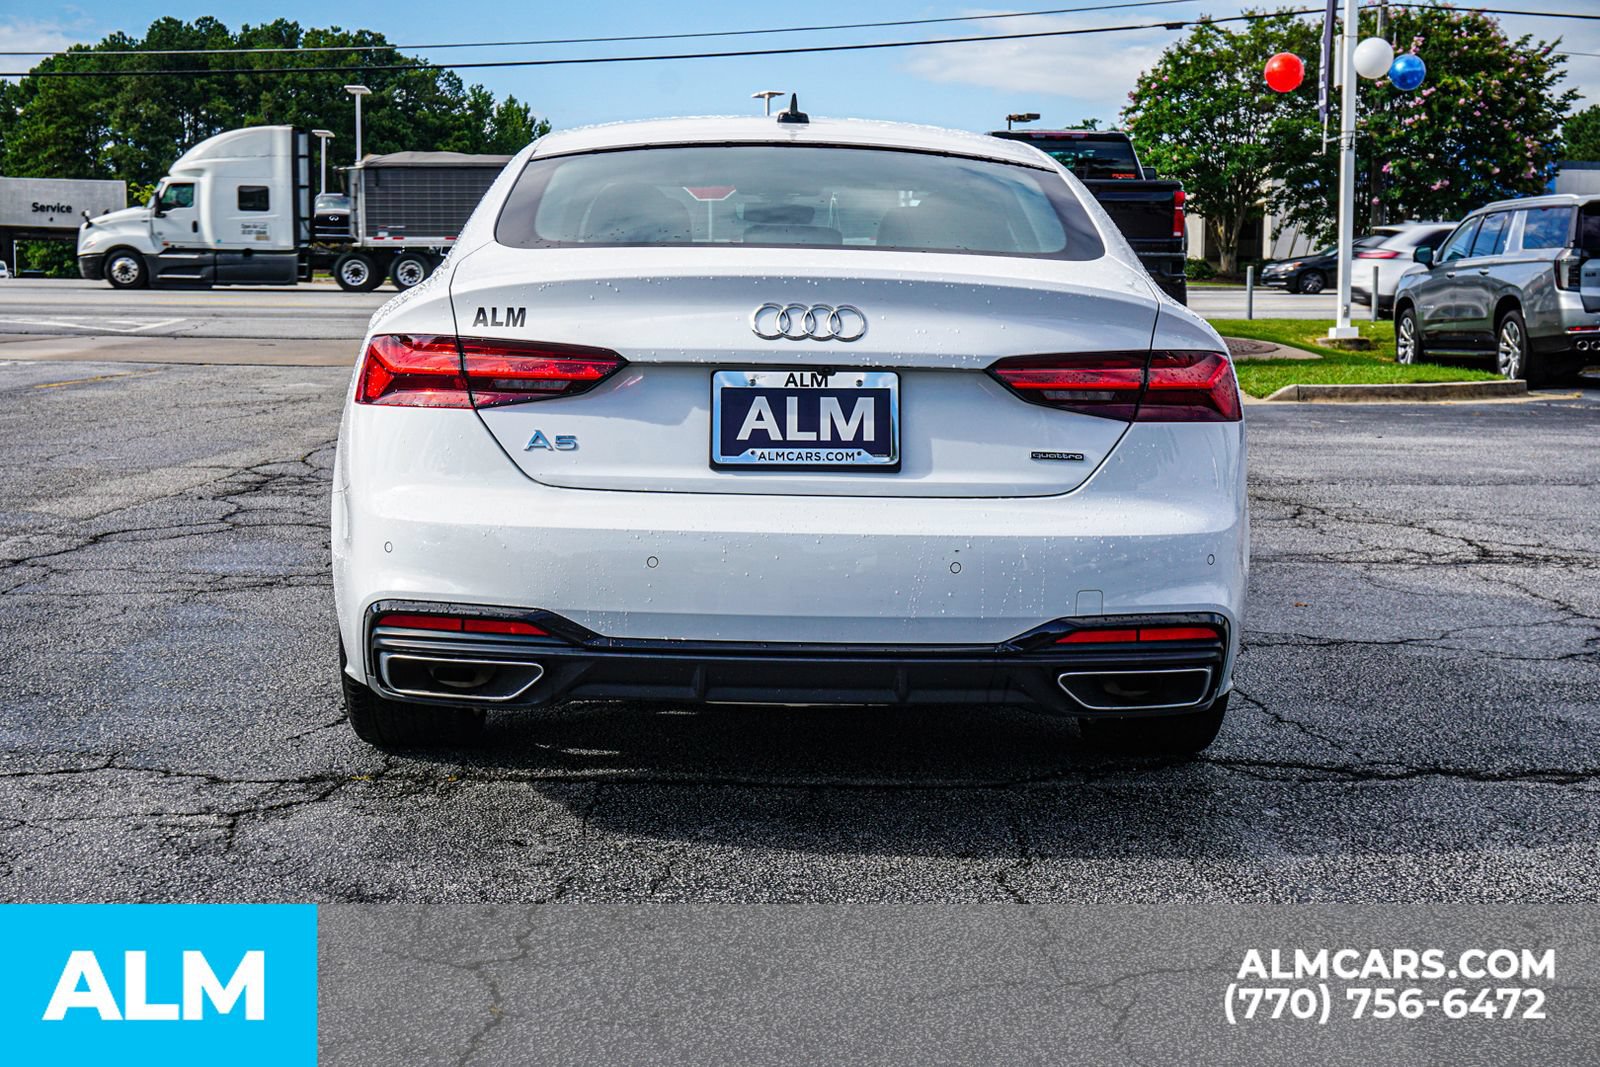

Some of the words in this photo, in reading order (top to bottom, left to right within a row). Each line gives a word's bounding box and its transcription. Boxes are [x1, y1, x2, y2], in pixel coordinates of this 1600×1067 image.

[32, 202, 72, 213] Service
[472, 307, 526, 327] ALM
[784, 373, 828, 387] ALM
[736, 396, 875, 441] ALM
[523, 430, 578, 451] A5
[758, 452, 855, 461] ALMCARS.COM
[1031, 452, 1084, 460] quattro
